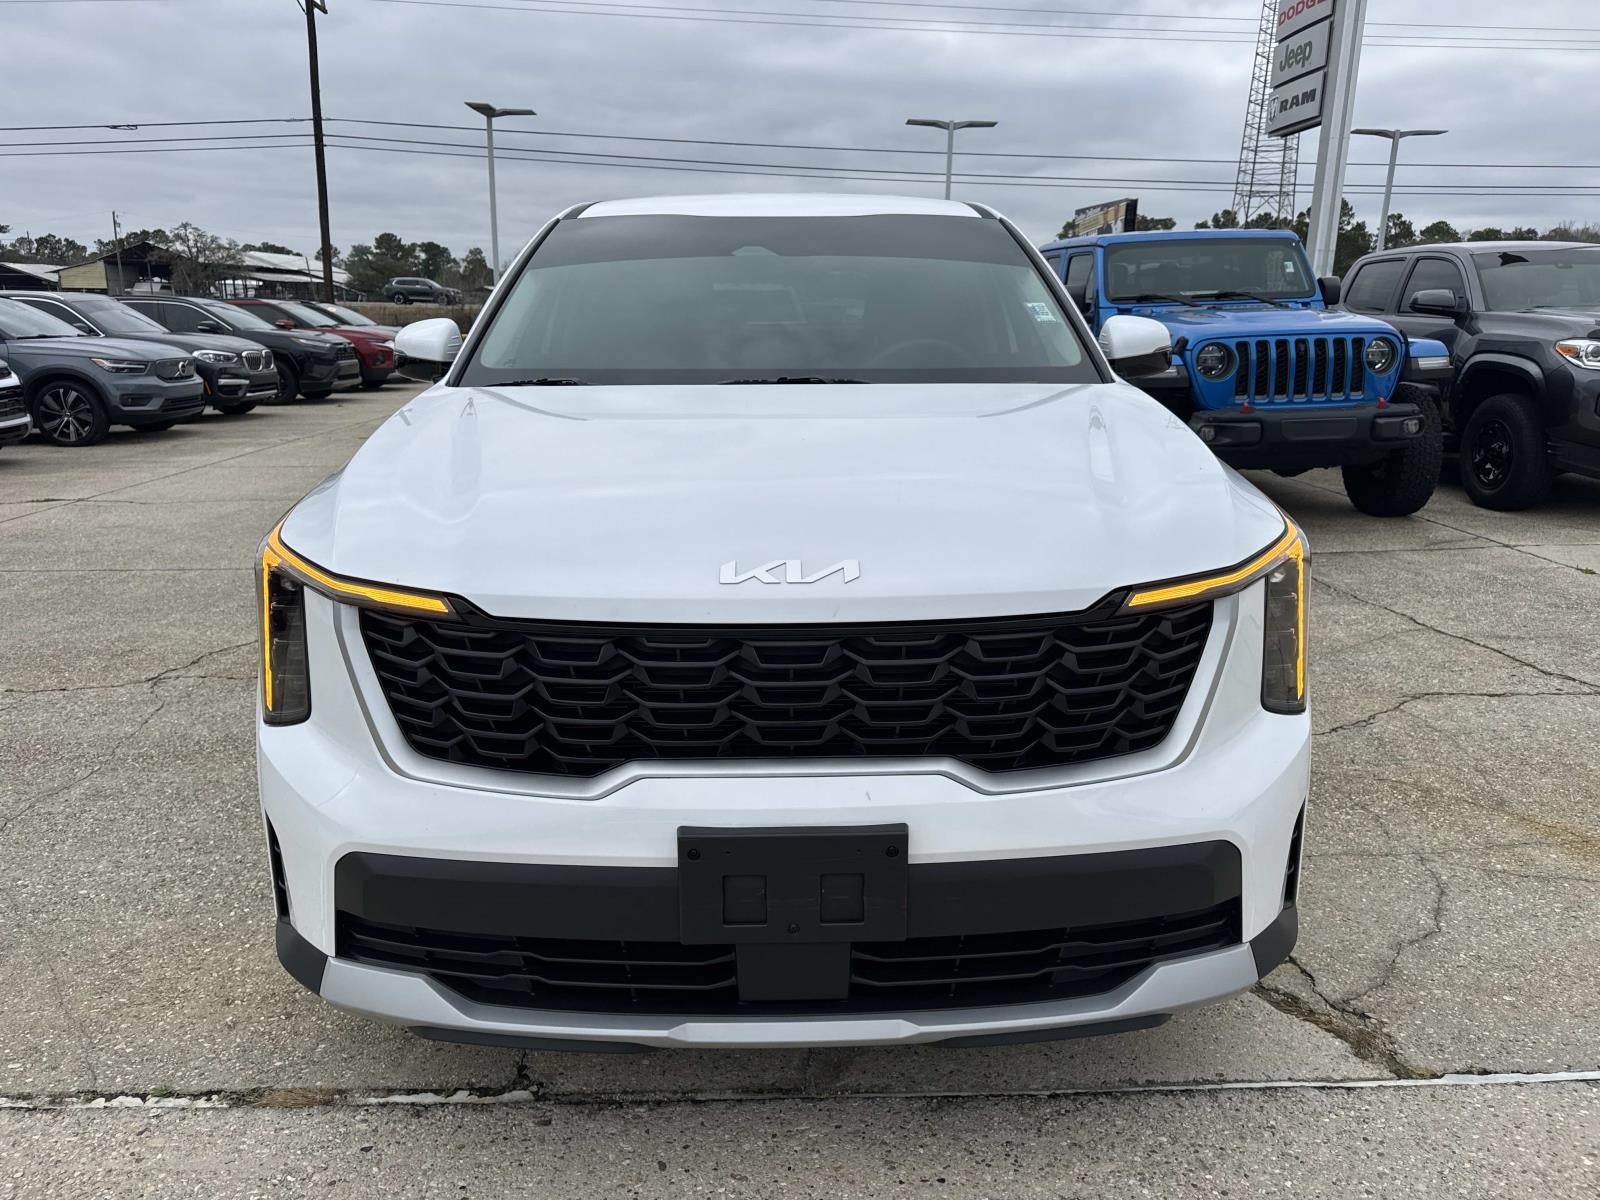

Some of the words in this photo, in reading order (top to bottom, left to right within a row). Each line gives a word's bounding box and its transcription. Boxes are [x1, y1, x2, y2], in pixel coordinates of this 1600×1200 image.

[1280, 41, 1312, 72] Jeep
[1280, 88, 1317, 113] RAM
[719, 559, 860, 584] KIA
